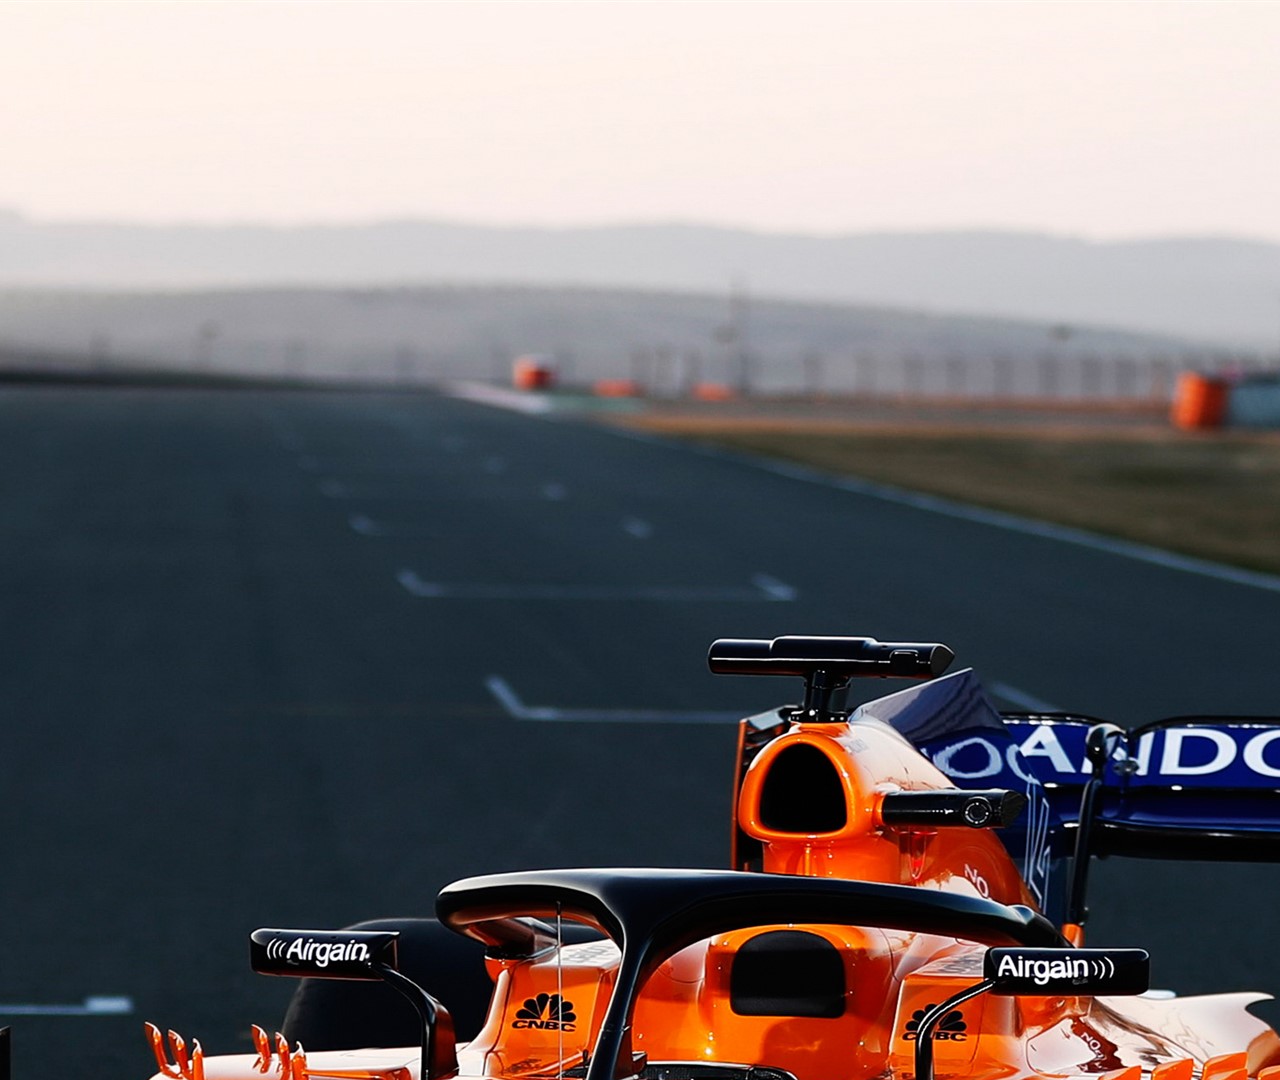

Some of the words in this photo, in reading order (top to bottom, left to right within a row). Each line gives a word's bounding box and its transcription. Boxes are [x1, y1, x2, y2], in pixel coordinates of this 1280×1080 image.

[286, 938, 369, 968] Airgain
[997, 954, 1089, 985] Airgain
[511, 1020, 577, 1033] CNBC
[902, 1031, 967, 1042] CBC
